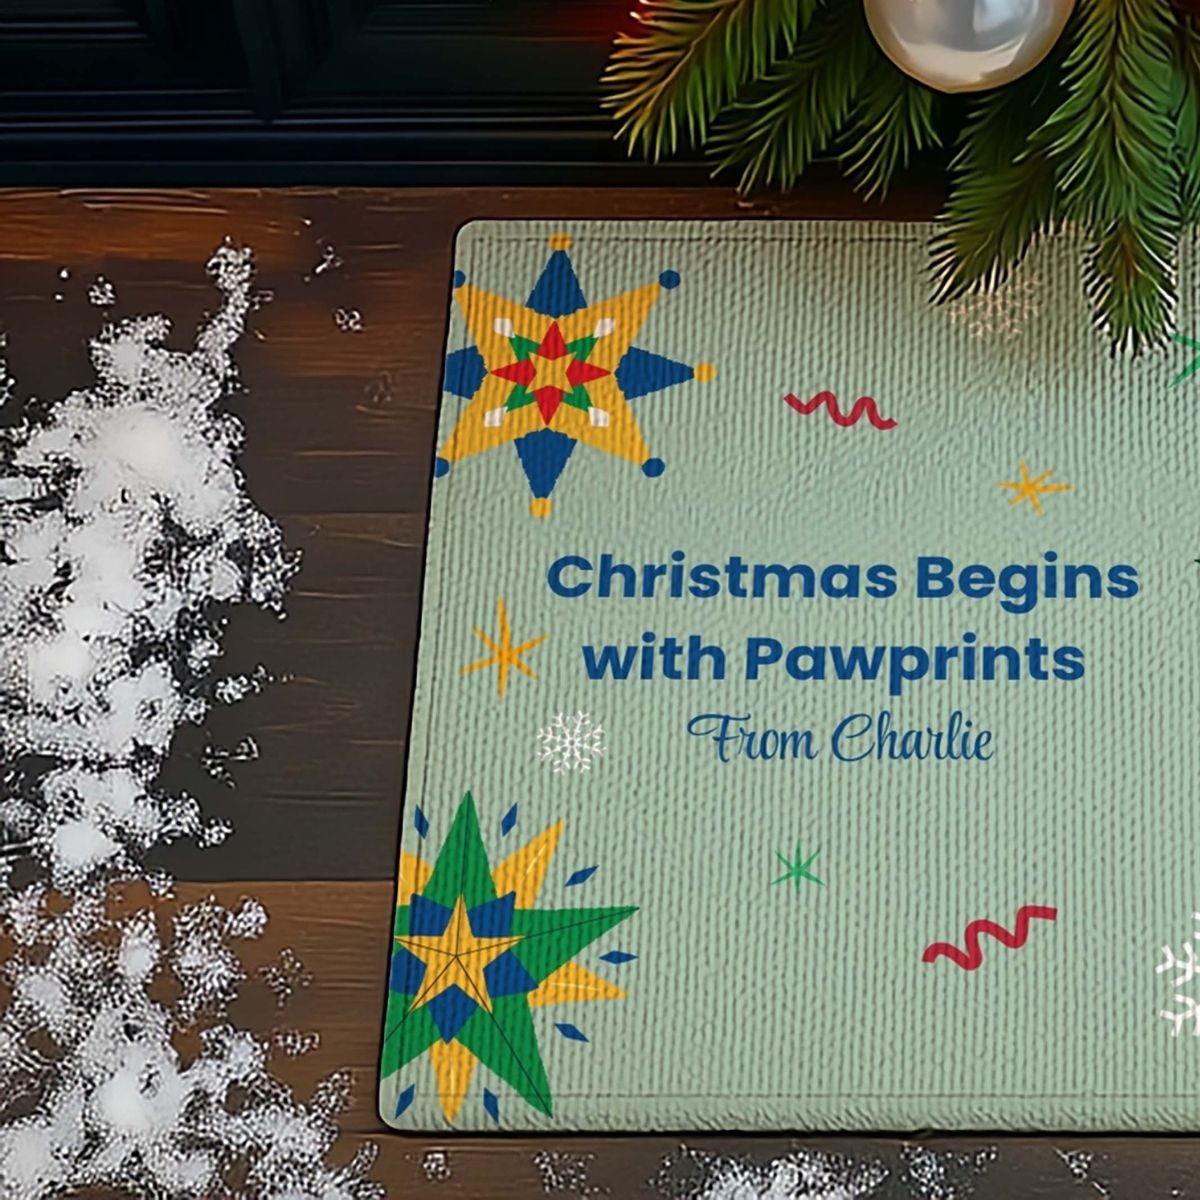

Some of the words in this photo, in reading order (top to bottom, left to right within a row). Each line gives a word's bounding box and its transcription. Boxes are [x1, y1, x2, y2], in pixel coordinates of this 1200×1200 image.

[546, 550, 898, 600] Christmas
[916, 550, 1140, 615] Begins
[581, 631, 727, 681] with
[745, 631, 1086, 697] Pawprints
[686, 713, 818, 763] From
[830, 709, 995, 763] Charlie
